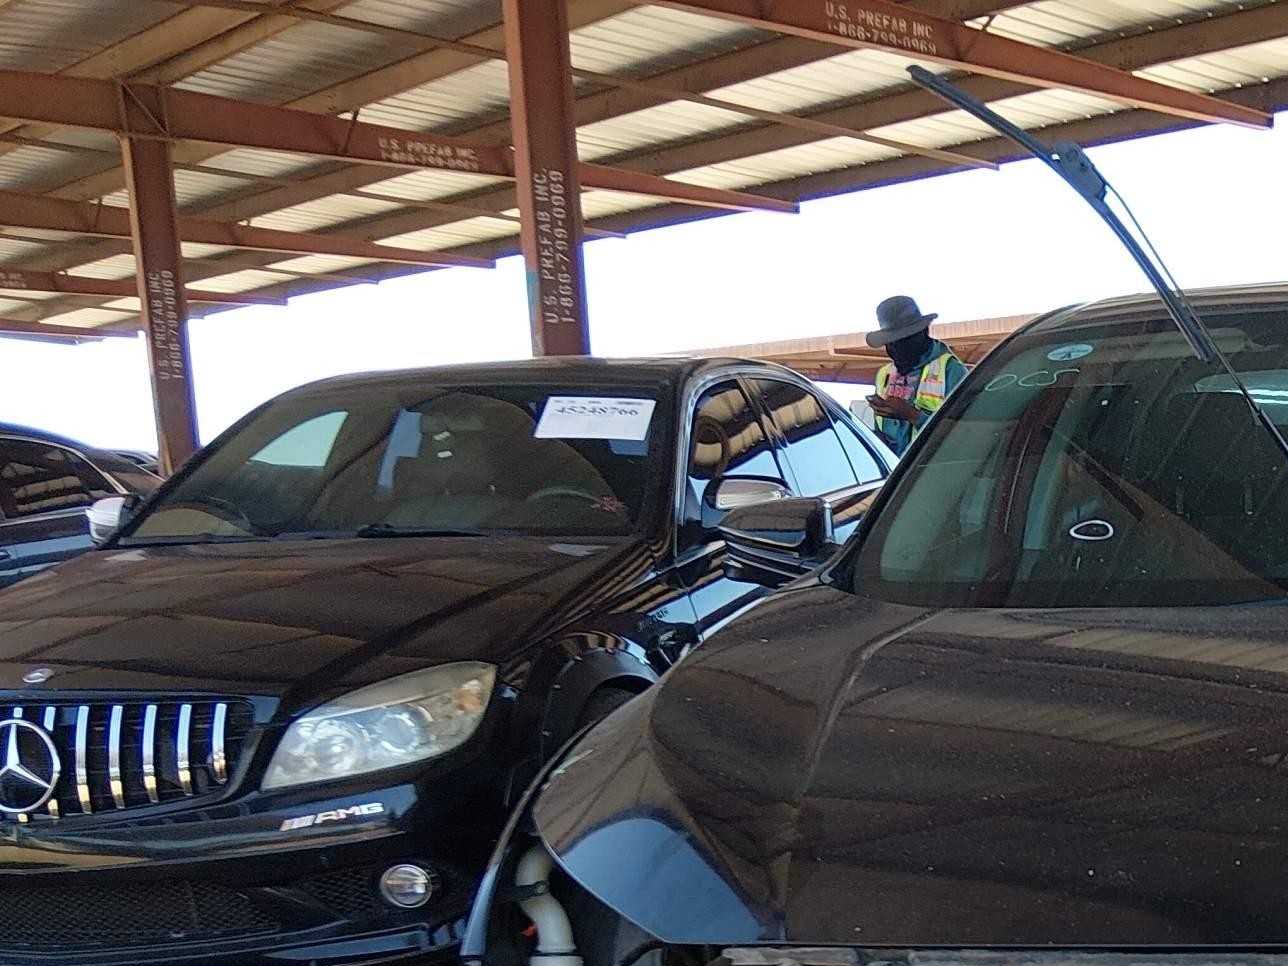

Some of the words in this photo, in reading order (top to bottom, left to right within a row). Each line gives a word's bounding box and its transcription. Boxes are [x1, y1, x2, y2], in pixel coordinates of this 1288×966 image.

[825, 2, 851, 21] U.S.
[857, 9, 907, 33] PREFAB
[537, 211, 555, 280] PREFAB
[314, 802, 385, 824] AMG
